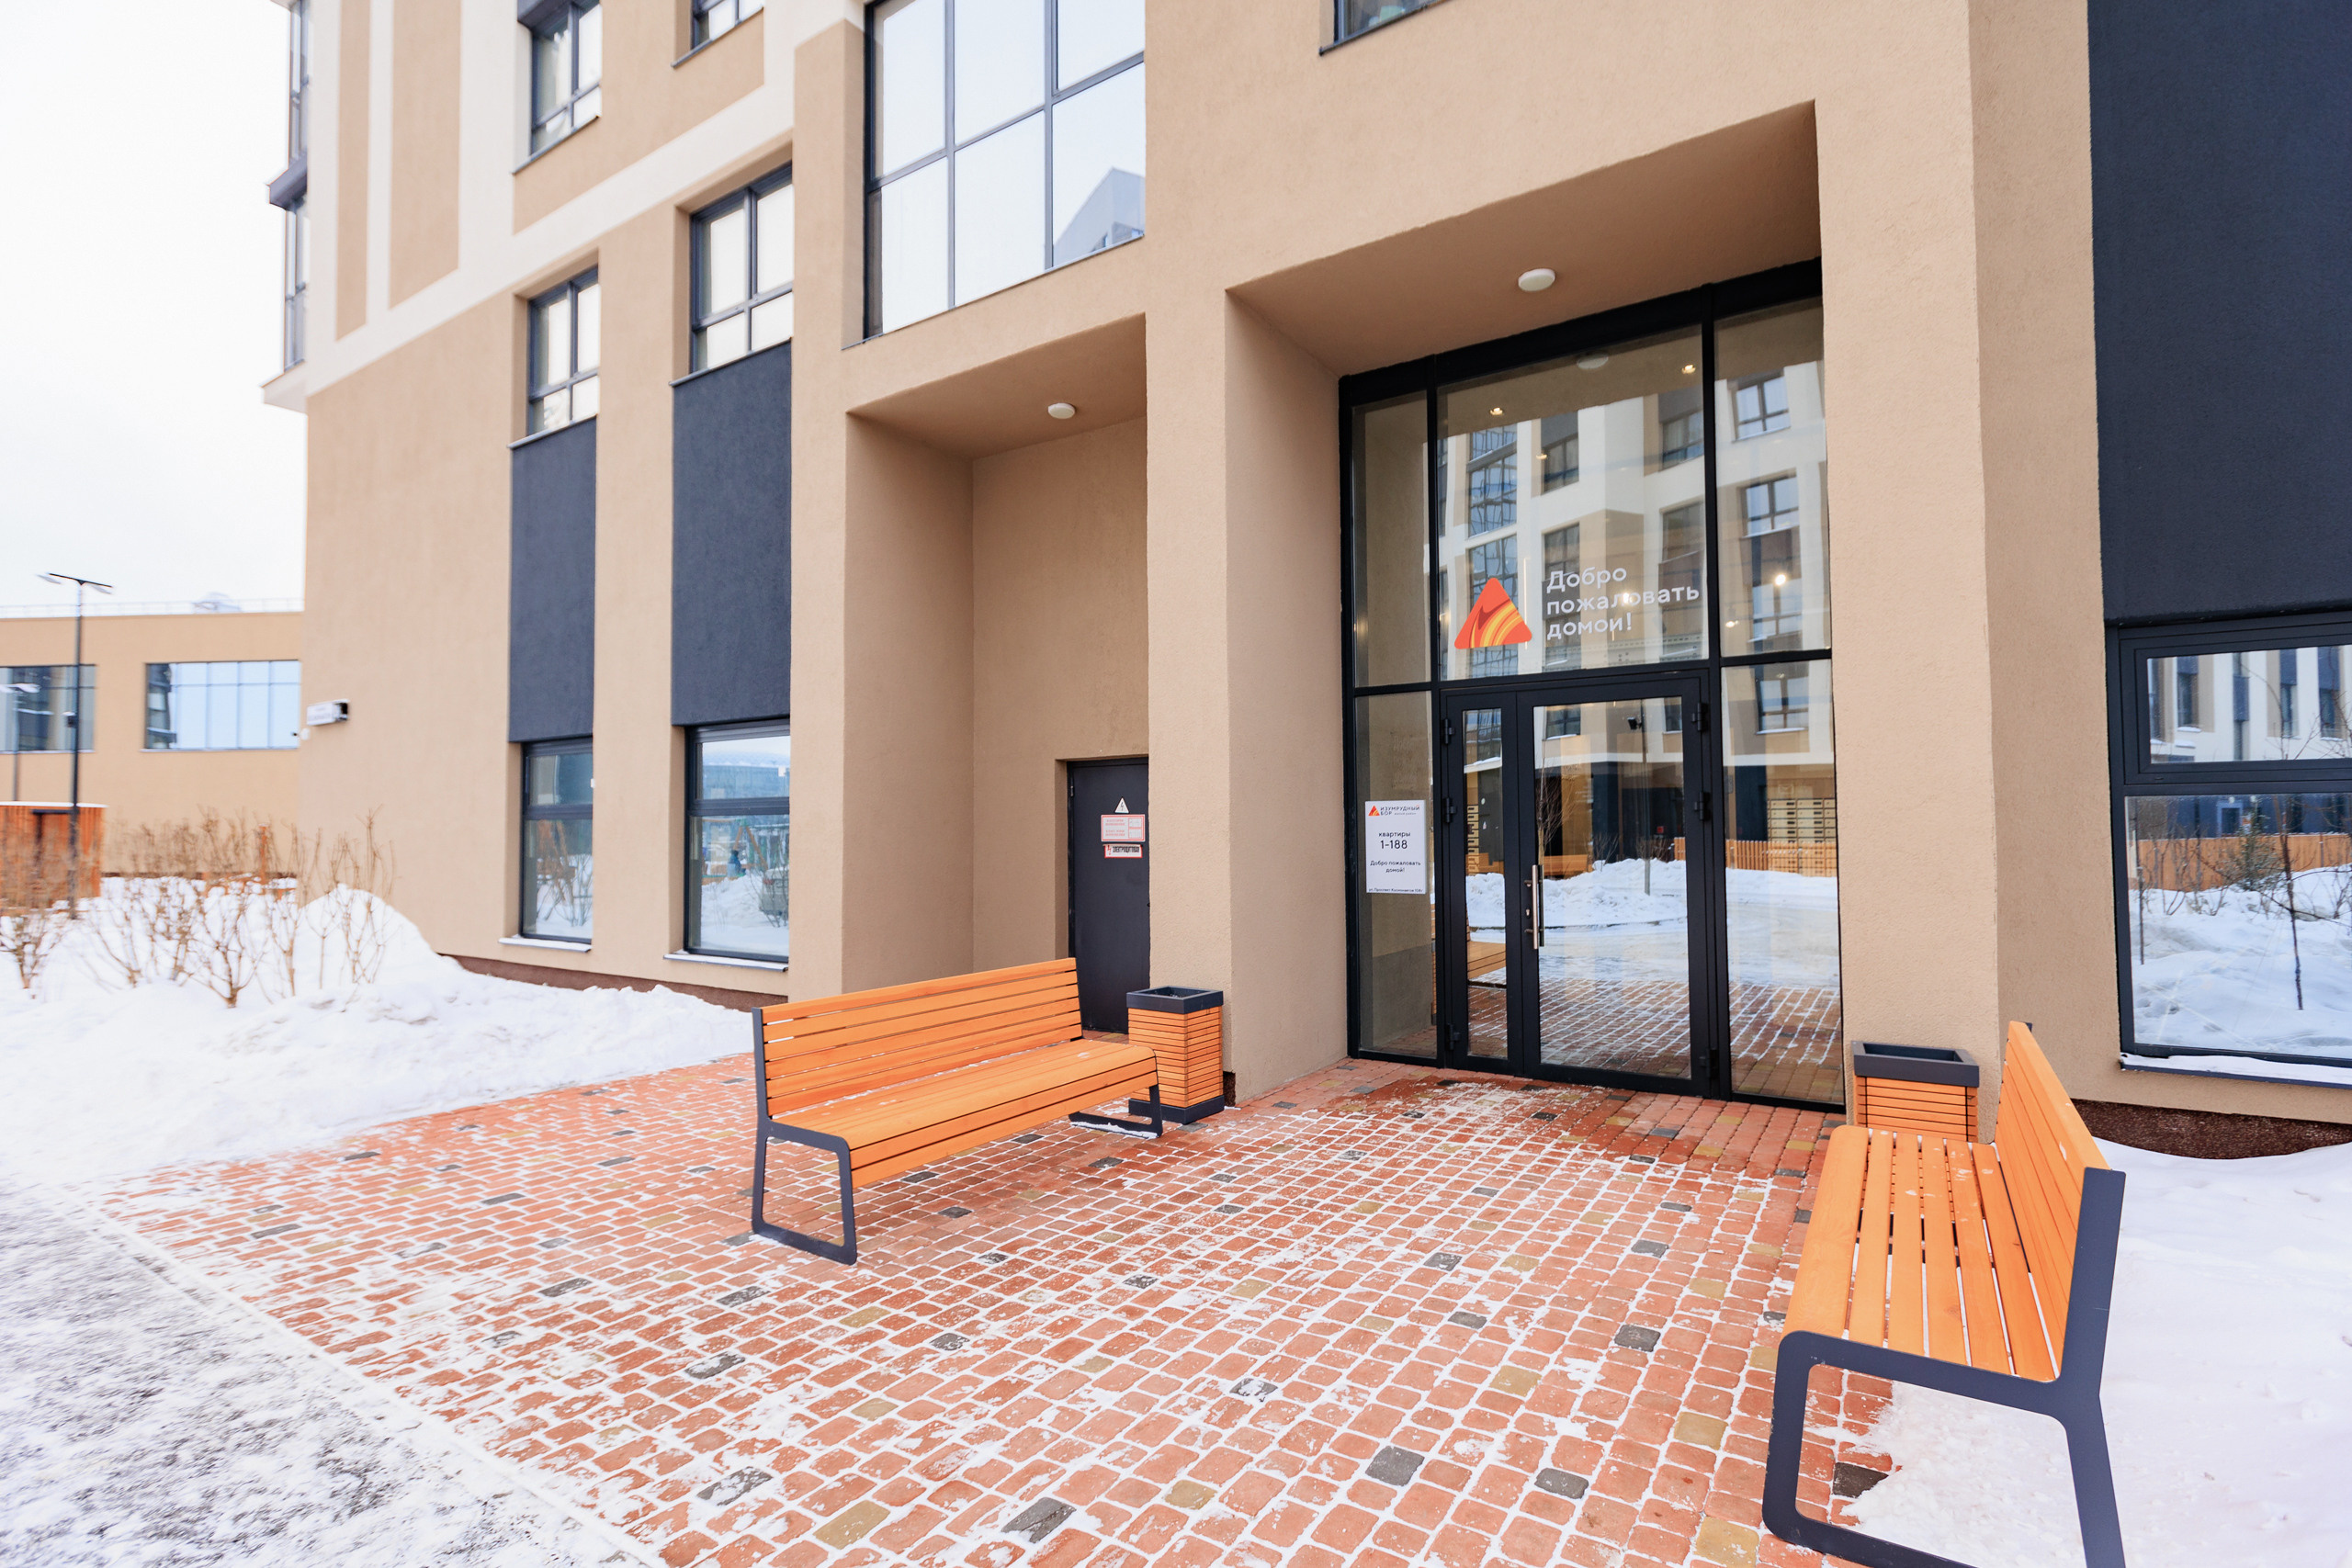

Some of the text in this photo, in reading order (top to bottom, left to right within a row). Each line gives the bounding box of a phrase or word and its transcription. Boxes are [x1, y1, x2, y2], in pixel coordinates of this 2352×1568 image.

[1546, 567, 1627, 594] Добро
[1546, 586, 1700, 615] пожаловать
[1380, 840, 1408, 850] 1-188
